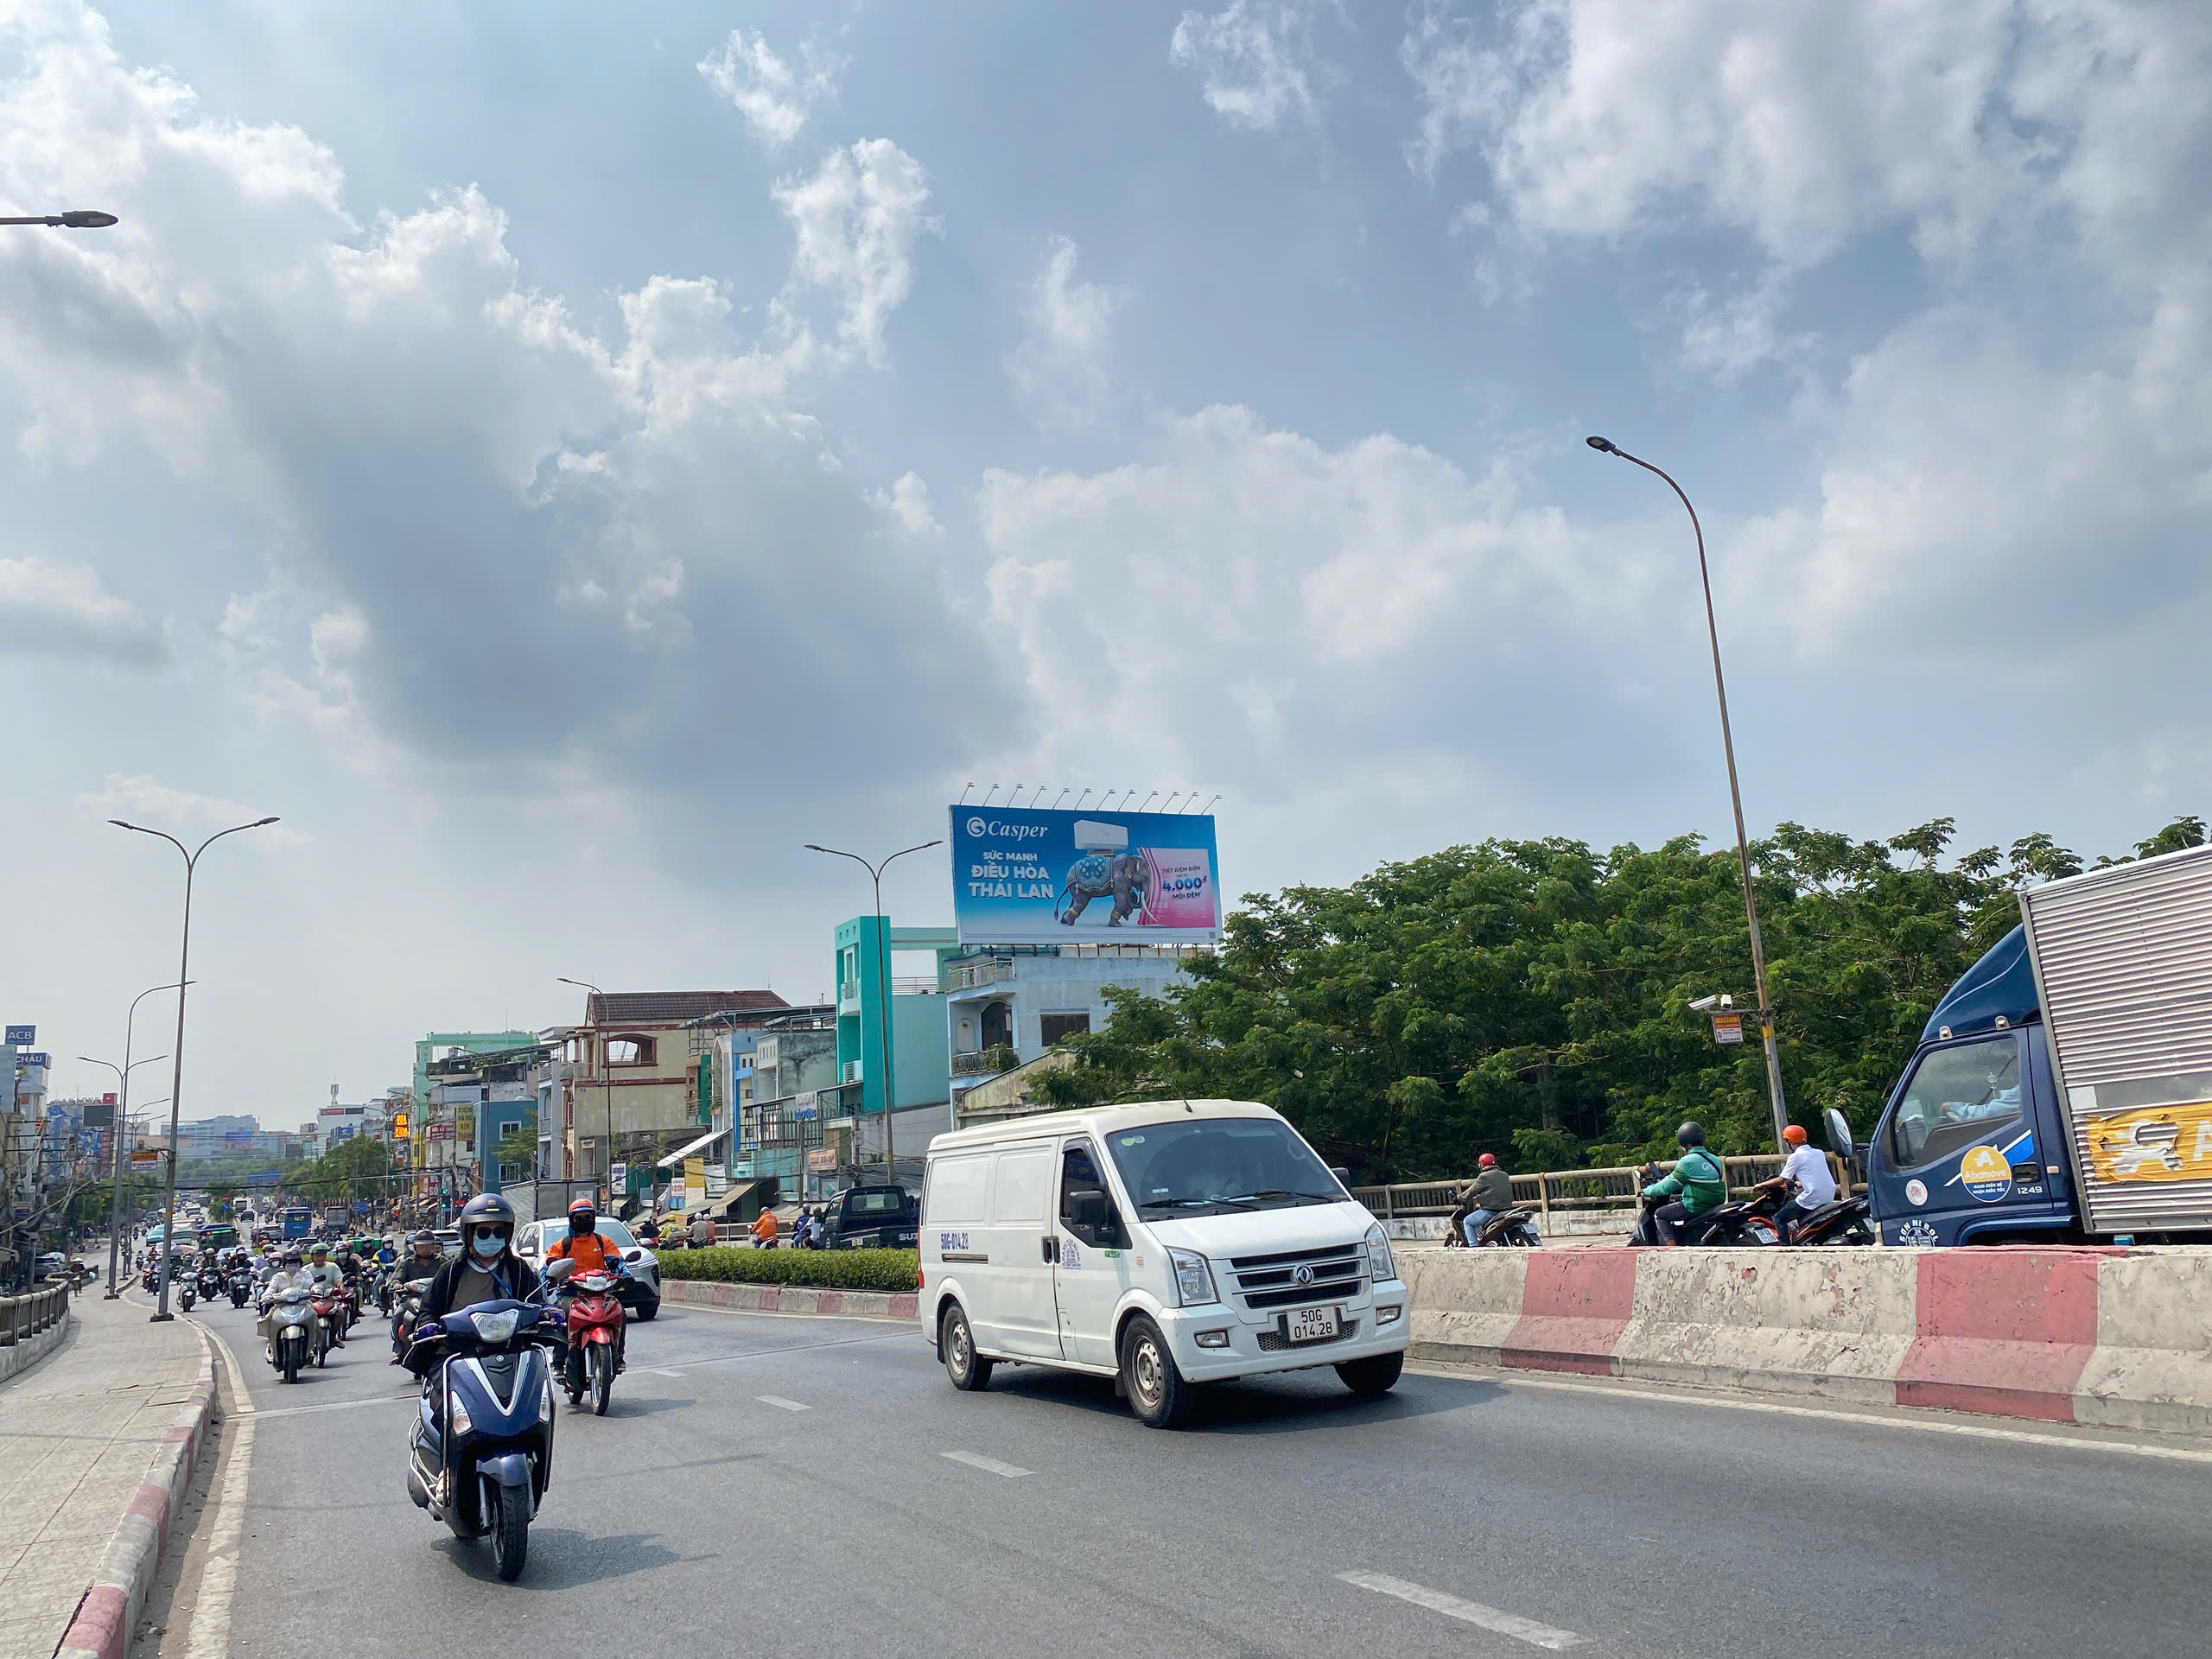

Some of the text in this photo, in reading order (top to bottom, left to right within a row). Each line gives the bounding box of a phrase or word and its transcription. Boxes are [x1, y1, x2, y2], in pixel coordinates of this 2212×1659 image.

[988, 820, 1048, 842] Casper
[982, 849, 1038, 862] SỨC MẠNH
[971, 860, 1050, 880] ĐIỀU HÒA
[968, 879, 1053, 899] THÁI LAN
[7, 1031, 33, 1039] ACB
[1966, 1169, 2006, 1180] Ahamove
[2018, 1185, 2043, 1194] 1249
[940, 1232, 969, 1250] 50G-014.28
[1300, 1309, 1323, 1323] 50G
[1294, 1322, 1332, 1338] 014.28
